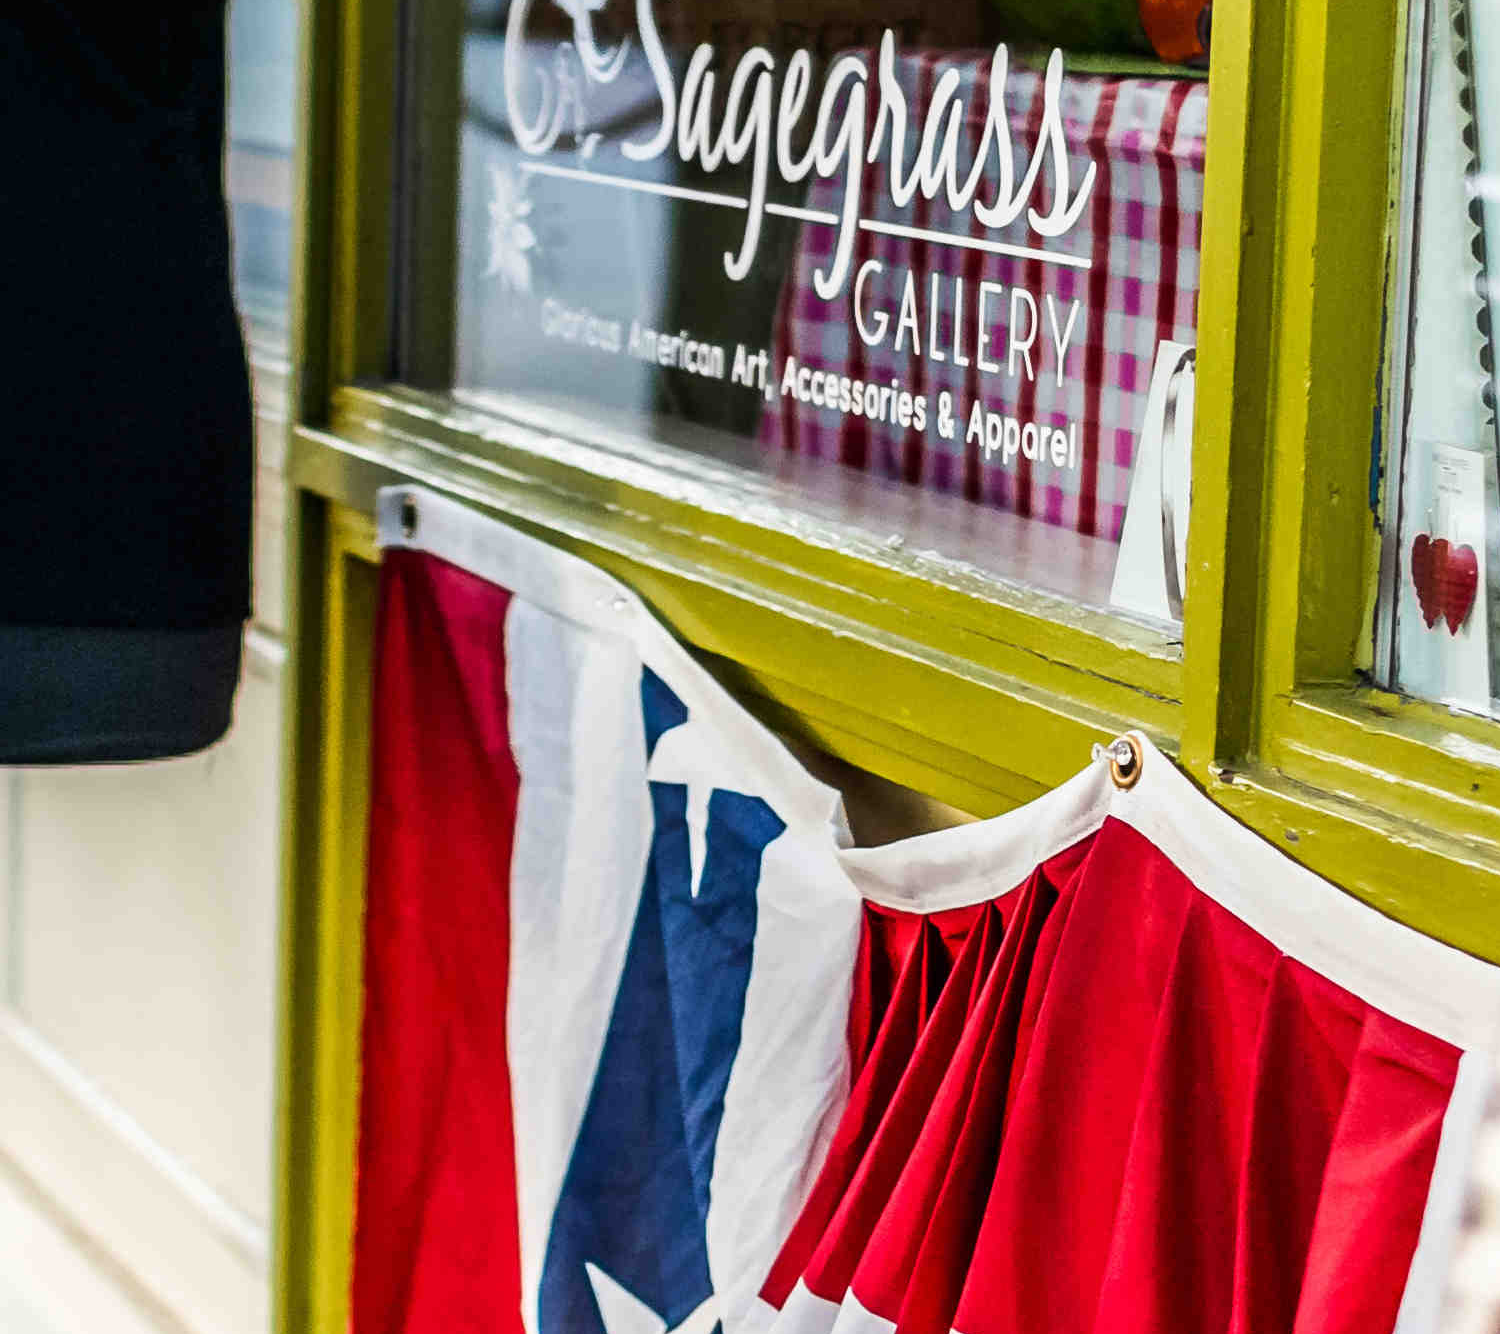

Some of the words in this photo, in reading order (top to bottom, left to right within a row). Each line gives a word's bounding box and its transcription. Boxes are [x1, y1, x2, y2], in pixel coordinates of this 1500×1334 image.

[855, 259, 1081, 388] GALLERY
[627, 320, 725, 380] American
[731, 343, 774, 402] Art,
[780, 355, 928, 431] Accessories
[937, 390, 955, 440] &
[966, 400, 1077, 469] Apparel
